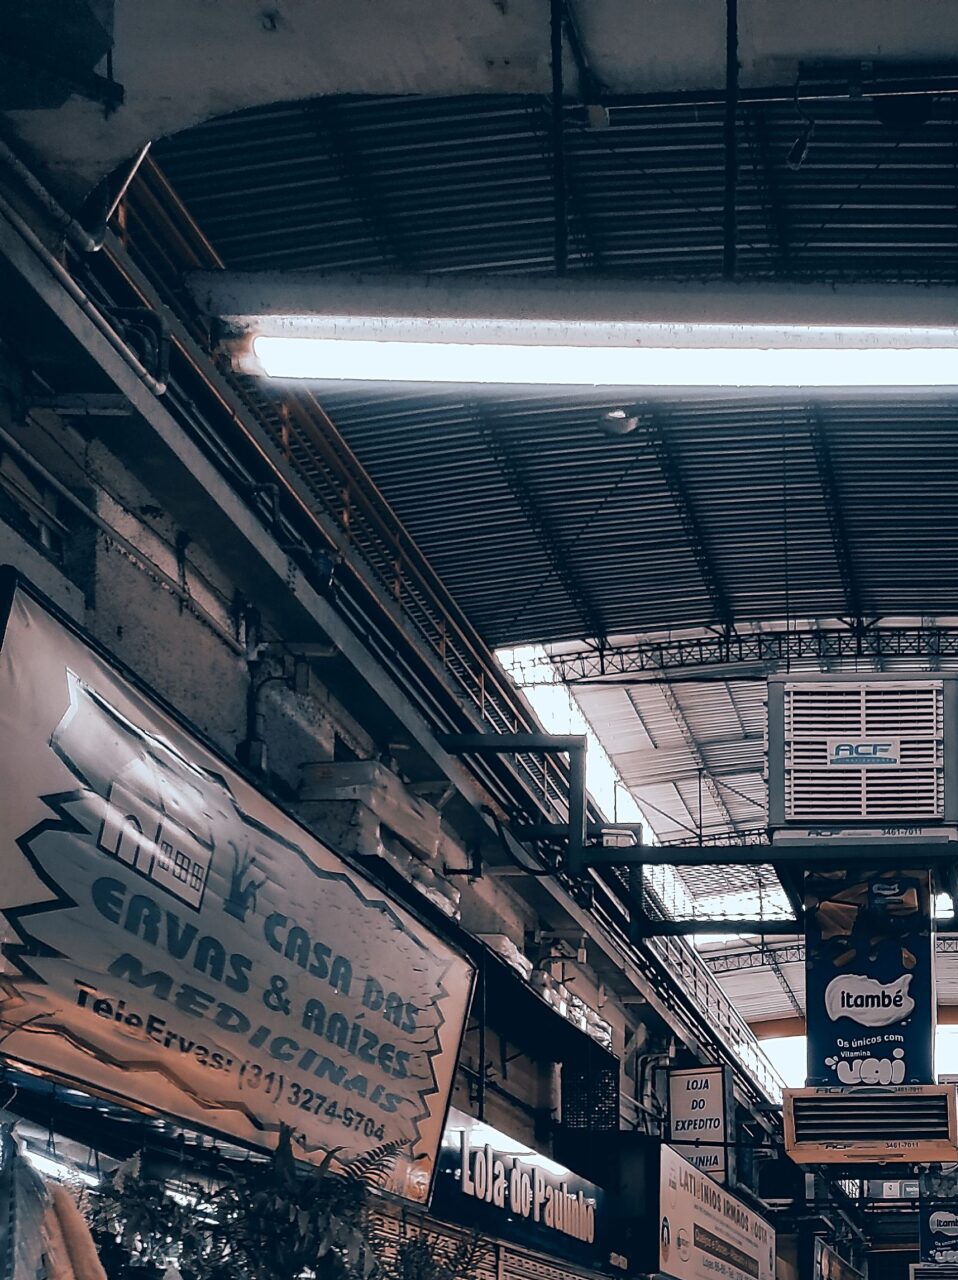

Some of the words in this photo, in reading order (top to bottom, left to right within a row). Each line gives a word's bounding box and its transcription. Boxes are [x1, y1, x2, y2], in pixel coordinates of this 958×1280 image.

[835, 744, 892, 756] ACF
[91, 876, 253, 994] ERVAS
[262, 975, 291, 1016] &
[302, 998, 412, 1080] RAÍZES
[264, 911, 353, 997] CASA
[361, 974, 421, 1035] DAS
[840, 989, 904, 1009] itambé
[107, 952, 402, 1114] MEDICINAIS
[837, 1038, 850, 1048] Os
[851, 1036, 882, 1048] únicos
[884, 1033, 904, 1043] com
[840, 1050, 871, 1058] Vitamina
[686, 1079, 709, 1091] LOJA
[238, 1059, 285, 1104] (31)
[287, 1082, 386, 1142] 3274-9704
[691, 1099, 706, 1111] DO
[675, 1118, 720, 1132] EXPEDITO
[511, 1158, 531, 1218] do
[534, 1167, 595, 1244] Paulinho
[679, 1166, 722, 1213] LATIÍNIOS
[724, 1198, 749, 1232] IRMÃOS
